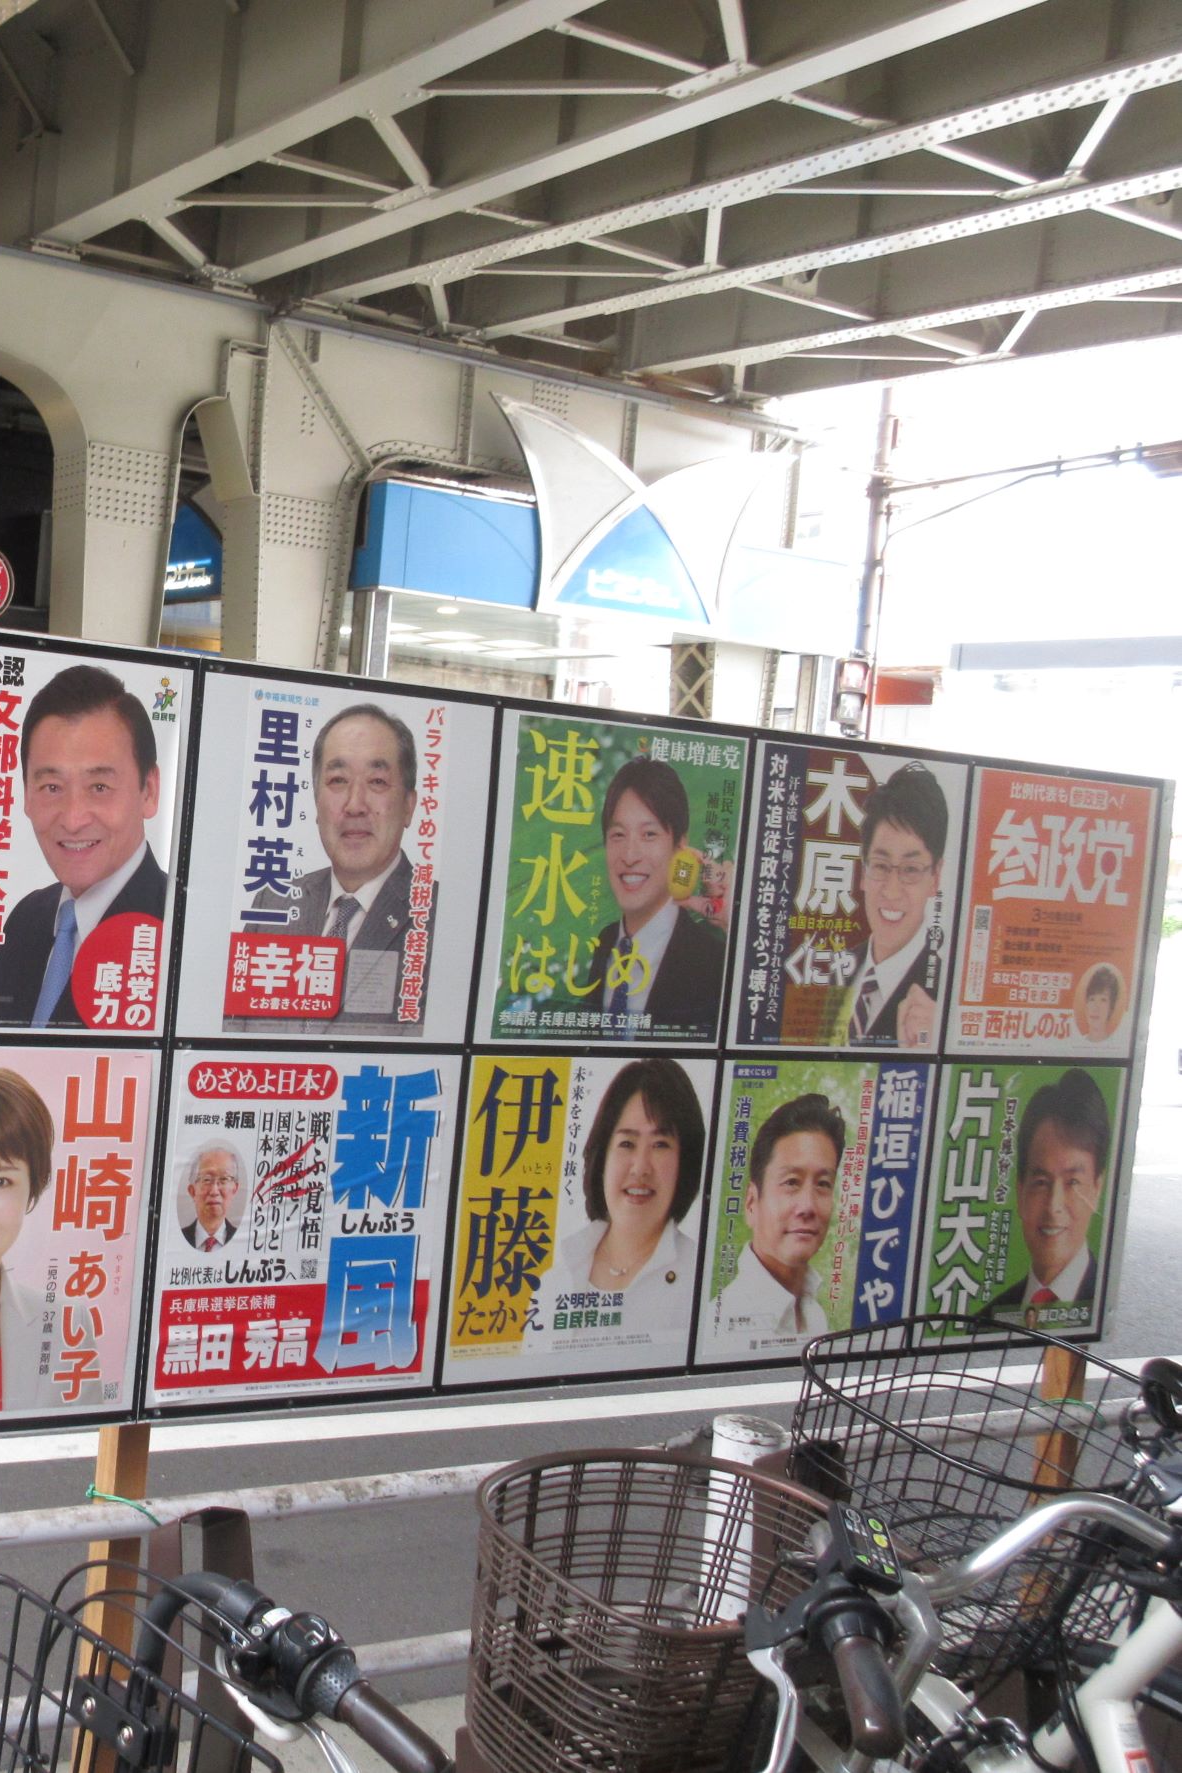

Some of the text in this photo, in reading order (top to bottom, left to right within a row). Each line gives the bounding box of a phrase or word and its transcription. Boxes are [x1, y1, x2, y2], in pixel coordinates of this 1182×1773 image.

[152, 711, 177, 722] 自民党
[299, 717, 314, 823] さとむら
[650, 736, 742, 771] 健康増進党
[239, 709, 301, 925] 里村英一
[513, 729, 600, 926] 速水
[793, 758, 868, 917] 木原
[397, 706, 446, 1023] バラマキやめて減税で経済成長
[988, 808, 1135, 907] 参政党
[764, 775, 801, 1023] 汗水流して働く人々が報われる社会へ
[788, 914, 862, 931] 祖国日本の再生へ
[92, 961, 124, 1025] 底力
[124, 923, 158, 1027] 自民党の
[231, 941, 250, 993] 比例は
[250, 942, 339, 996] 幸福
[509, 932, 652, 997] はじめ
[784, 948, 858, 987] くにや
[249, 997, 332, 1011] とお書きください
[498, 1009, 538, 1028] 参議院
[539, 1011, 613, 1029] 兵庫県選挙区
[615, 1014, 652, 1030] 立候補
[984, 1009, 1072, 1039] 西村しのぶ
[196, 1068, 332, 1097] めざめよ日本!
[184, 1111, 256, 1130] 維新政党・新風
[563, 1065, 587, 1206] 未来を守り抜く。
[994, 1097, 1018, 1205] 日本維新の会
[251, 1111, 274, 1250] 日本のくらし
[267, 1111, 291, 1251] 国家の誇りと
[300, 1111, 331, 1250] 戦ふ覚悟
[459, 1065, 564, 1300] 伊藤
[522, 1163, 553, 1175] いとう
[859, 1069, 919, 1323] 稲垣ひでや
[929, 1069, 1000, 1331] 片山大介
[52, 1056, 137, 1403] 山崎あい子
[313, 1065, 443, 1375] 新風
[340, 1213, 416, 1234] しんぷう
[169, 1259, 297, 1286] 比例代表はしんぷうへ
[169, 1294, 276, 1315] 兵庫県選挙区候補
[555, 1291, 625, 1311] 公明党公認
[39, 1258, 59, 1376] 二児の母 37歳 薬剤師
[163, 1317, 312, 1376] 黒田 秀高
[456, 1297, 545, 1338] たかえ
[553, 1310, 622, 1331] 自民党推薦
